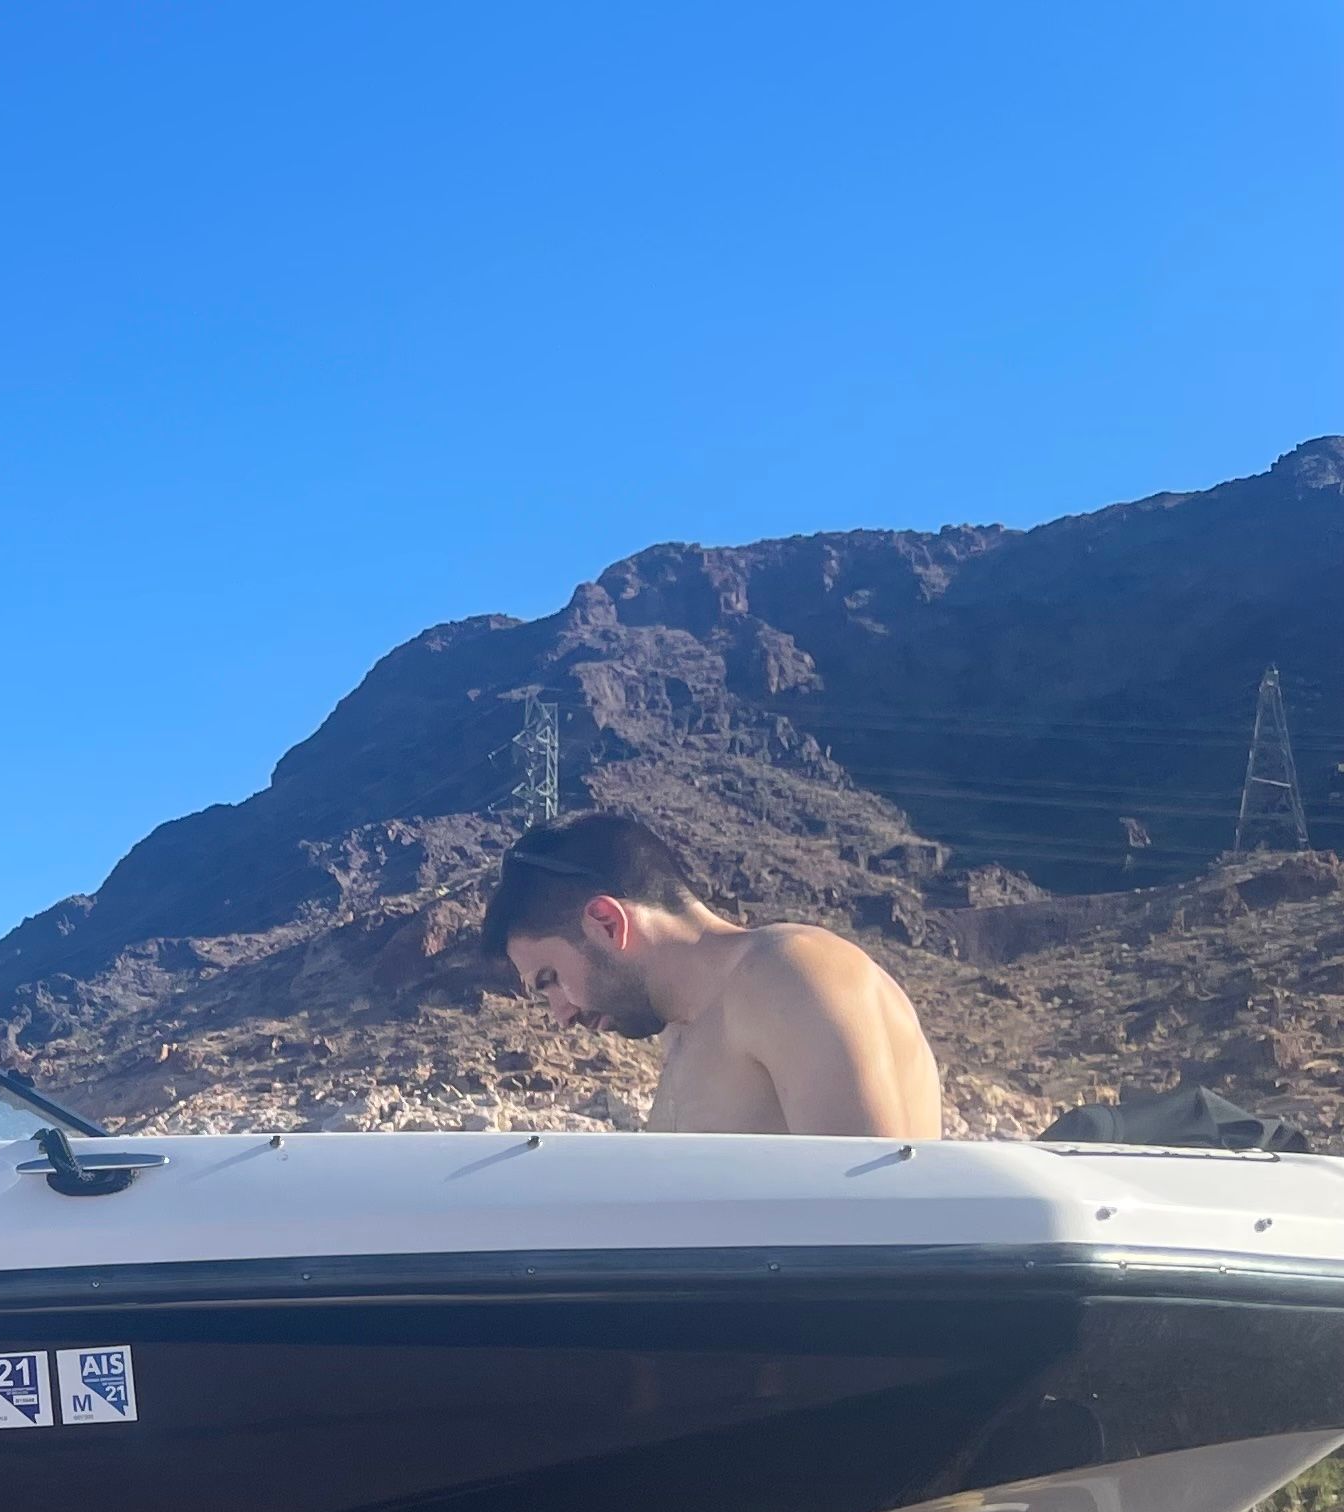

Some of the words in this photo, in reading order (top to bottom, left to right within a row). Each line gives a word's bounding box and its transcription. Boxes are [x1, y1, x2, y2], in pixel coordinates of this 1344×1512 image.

[82, 1353, 124, 1377] AIS
[104, 1385, 126, 1402] 21
[72, 1394, 93, 1413] M
